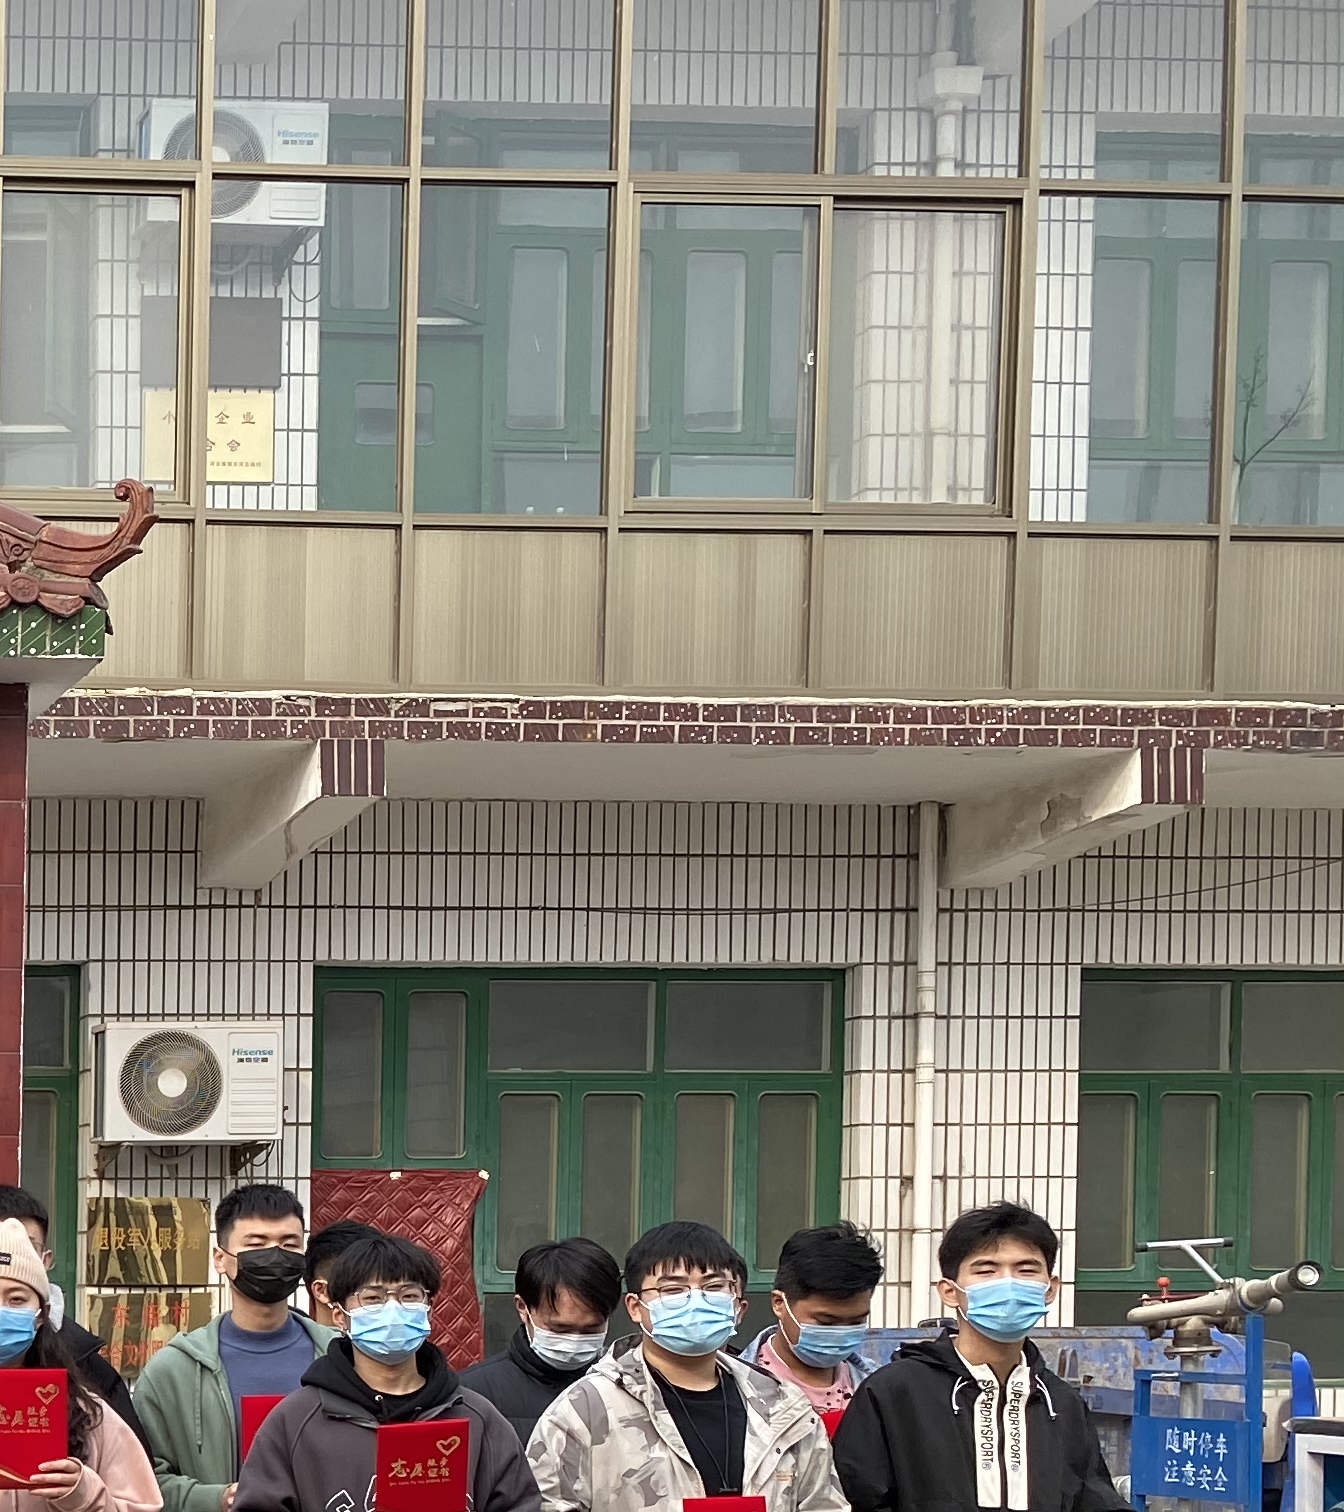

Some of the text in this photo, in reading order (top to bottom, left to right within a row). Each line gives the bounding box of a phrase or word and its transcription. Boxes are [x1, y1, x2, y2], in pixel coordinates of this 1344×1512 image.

[231, 1048, 274, 1056] Hisense
[1165, 1425, 1229, 1462] 随时停车
[1164, 1459, 1229, 1492] 注意安全
